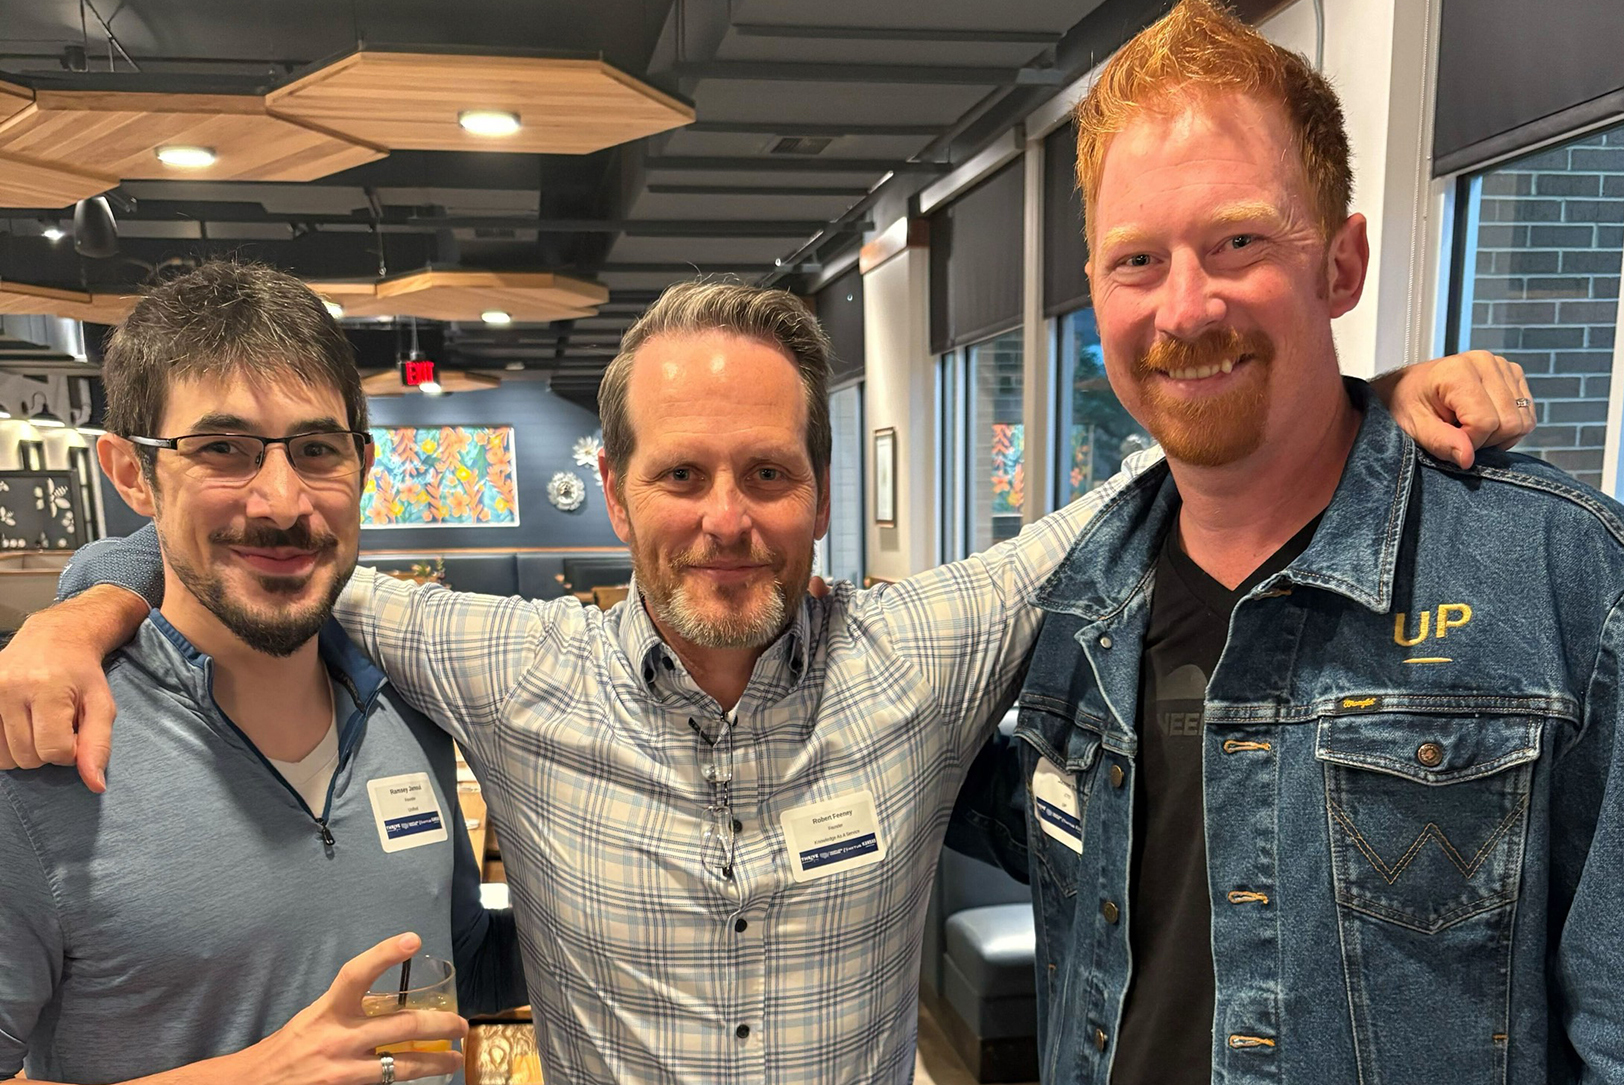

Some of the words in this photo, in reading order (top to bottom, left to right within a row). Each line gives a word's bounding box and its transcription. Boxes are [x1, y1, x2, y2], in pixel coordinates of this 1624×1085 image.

[406, 361, 434, 385] EXIT
[1393, 603, 1473, 647] UP
[812, 815, 832, 824] Robert
[832, 810, 853, 820] Feeney
[814, 835, 836, 845] Knowledge
[846, 829, 860, 837] Service
